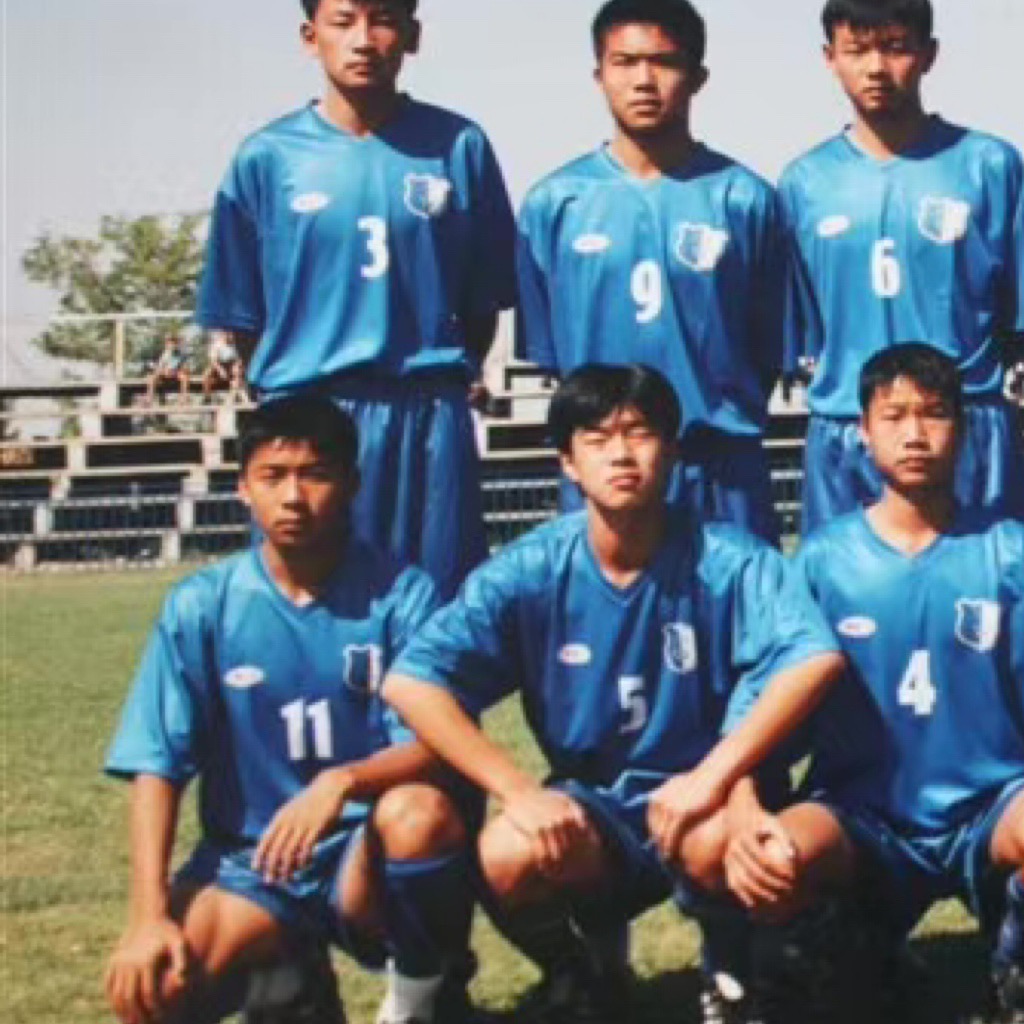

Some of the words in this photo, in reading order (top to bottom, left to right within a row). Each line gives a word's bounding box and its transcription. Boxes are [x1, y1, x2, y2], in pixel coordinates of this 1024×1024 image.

[358, 214, 390, 279] 3
[870, 237, 901, 297] 6
[630, 260, 662, 323] 9
[618, 676, 648, 734] 5
[898, 649, 937, 715] 4
[281, 699, 333, 760] 11
